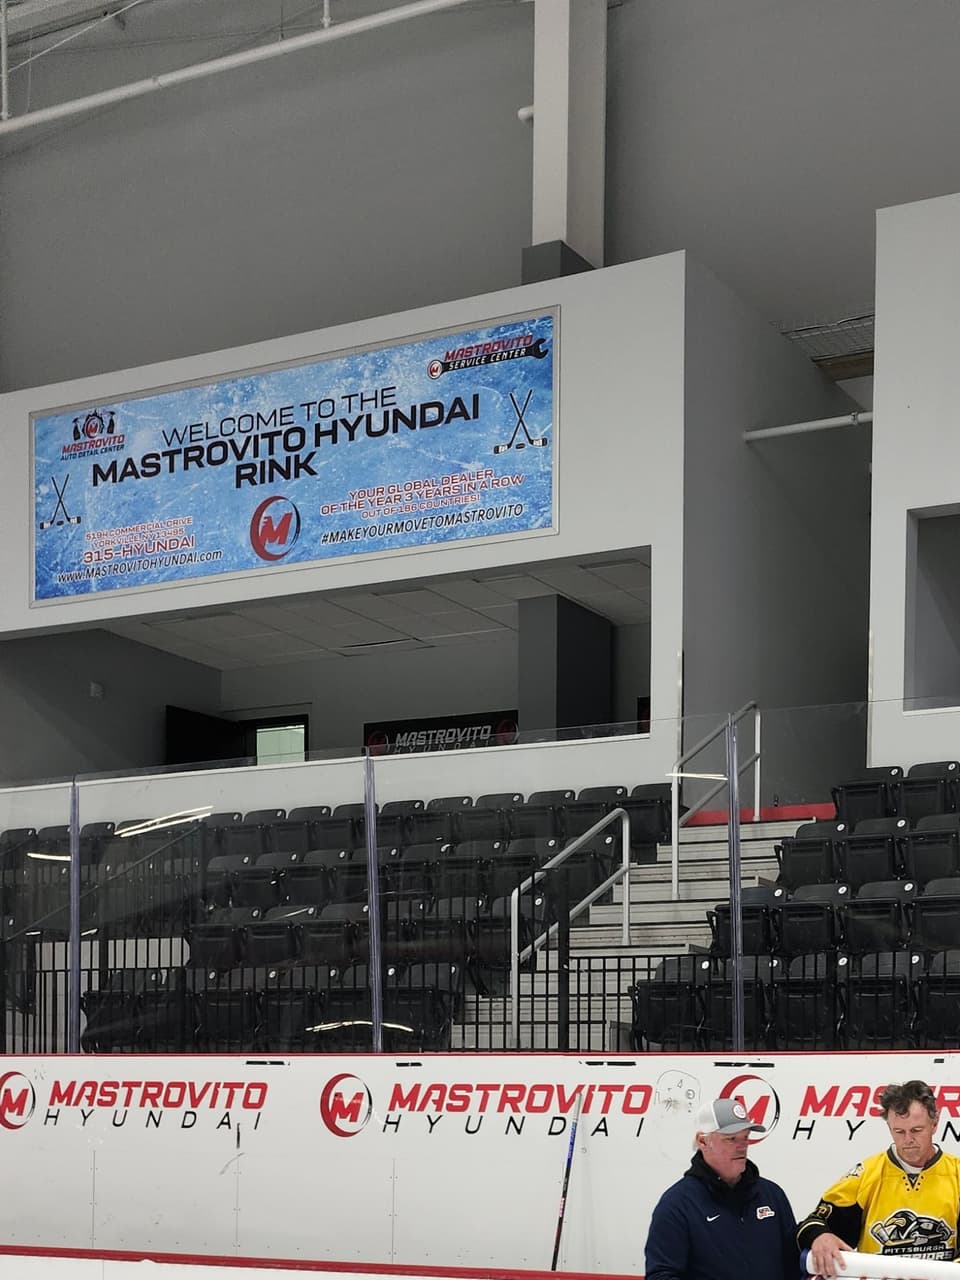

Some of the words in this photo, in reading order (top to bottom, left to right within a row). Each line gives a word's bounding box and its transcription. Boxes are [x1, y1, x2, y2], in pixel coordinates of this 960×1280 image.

[444, 335, 533, 361] MASTROVITO
[448, 354, 485, 370] SERVICE
[490, 348, 526, 361] CENTER
[162, 406, 294, 446] WELCOME
[300, 399, 335, 421] TO
[341, 386, 397, 412] THE
[60, 453, 78, 461] AUTO
[100, 445, 125, 454] CENTER
[62, 434, 125, 454] MASTROVITO
[92, 426, 306, 487] MASTROVITO
[314, 393, 480, 447] HYUNDAI
[235, 452, 318, 488] RINK
[321, 505, 338, 515] OF
[340, 500, 365, 511] THE
[368, 494, 401, 507] YEAR
[405, 492, 413, 502] 3
[416, 484, 461, 499] YEARS
[463, 480, 477, 492] IN
[480, 479, 488, 489] A
[491, 474, 524, 486] ROW
[350, 487, 385, 499] YOUR
[388, 478, 438, 494] GLOBAL
[441, 469, 494, 487] DEALER
[109, 521, 164, 537] COMMERCIAL
[166, 516, 192, 527] DRIVE
[321, 503, 524, 544] #MAKEYOURMOVETOMASTROVITO
[361, 510, 382, 519] OUT
[83, 535, 195, 564] 315-HYUNDAI
[57, 550, 222, 583] www.MASTROVITOHYUNDAI.com
[395, 725, 492, 747] MASTROVITO
[49, 1080, 268, 1109] MASTROVITO
[387, 1083, 653, 1115] MASTROVITO
[44, 1109, 261, 1130] HYUNDAI
[382, 1114, 645, 1138] HYUNDAI
[884, 1239, 945, 1254] PITTSBURGH
